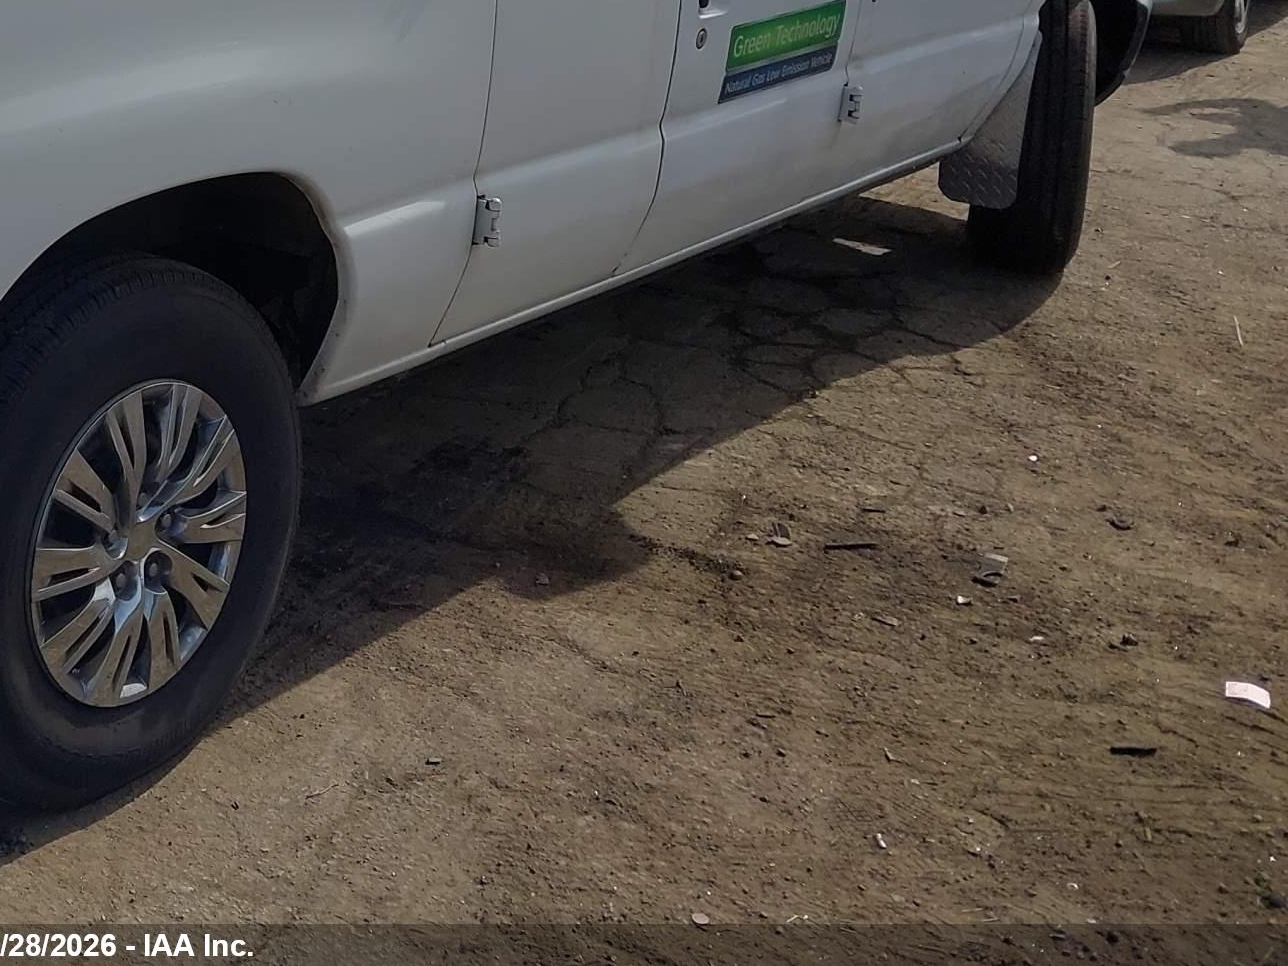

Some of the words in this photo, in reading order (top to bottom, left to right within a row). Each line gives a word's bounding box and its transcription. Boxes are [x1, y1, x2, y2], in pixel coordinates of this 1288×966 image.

[733, 33, 770, 57] Green
[775, 13, 841, 46] Technology
[725, 76, 752, 93] Natural
[752, 72, 766, 87] Gas
